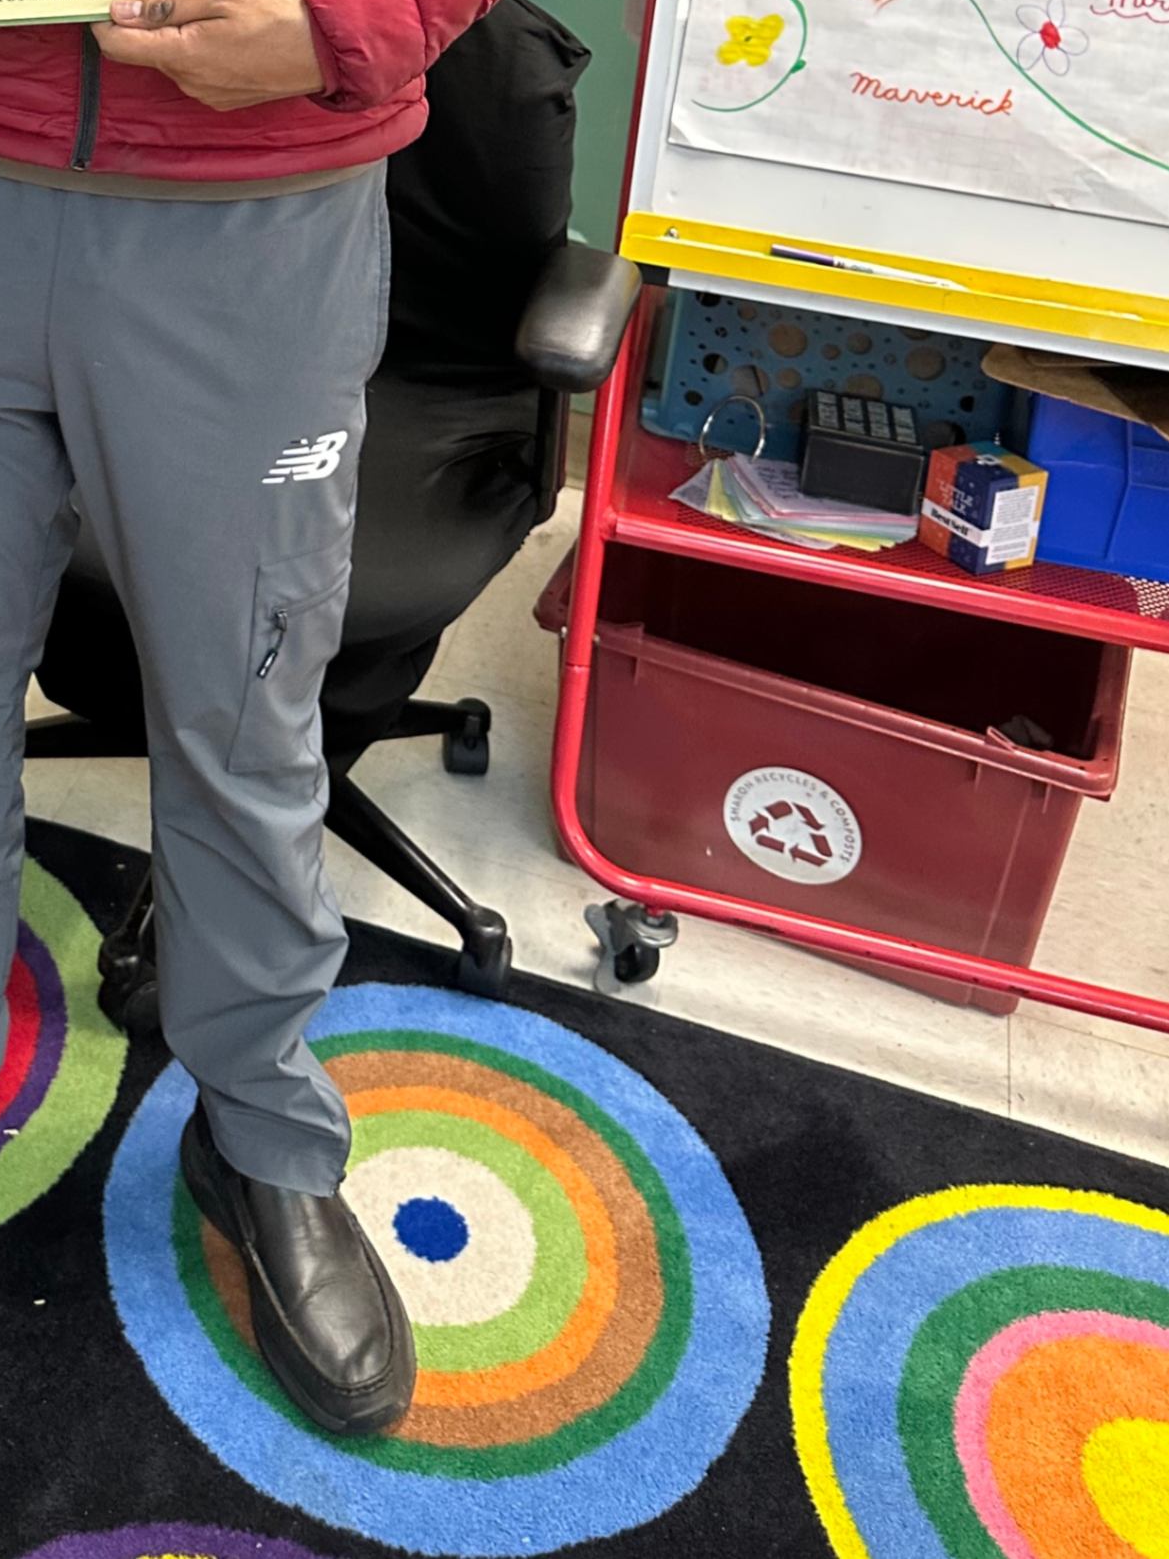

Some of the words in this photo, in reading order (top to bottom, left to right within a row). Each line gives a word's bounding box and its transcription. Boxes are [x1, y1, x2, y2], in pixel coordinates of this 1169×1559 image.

[729, 781, 754, 822] SHARON
[753, 771, 817, 792] RECYCLES
[829, 799, 855, 863] COMPOSTS
